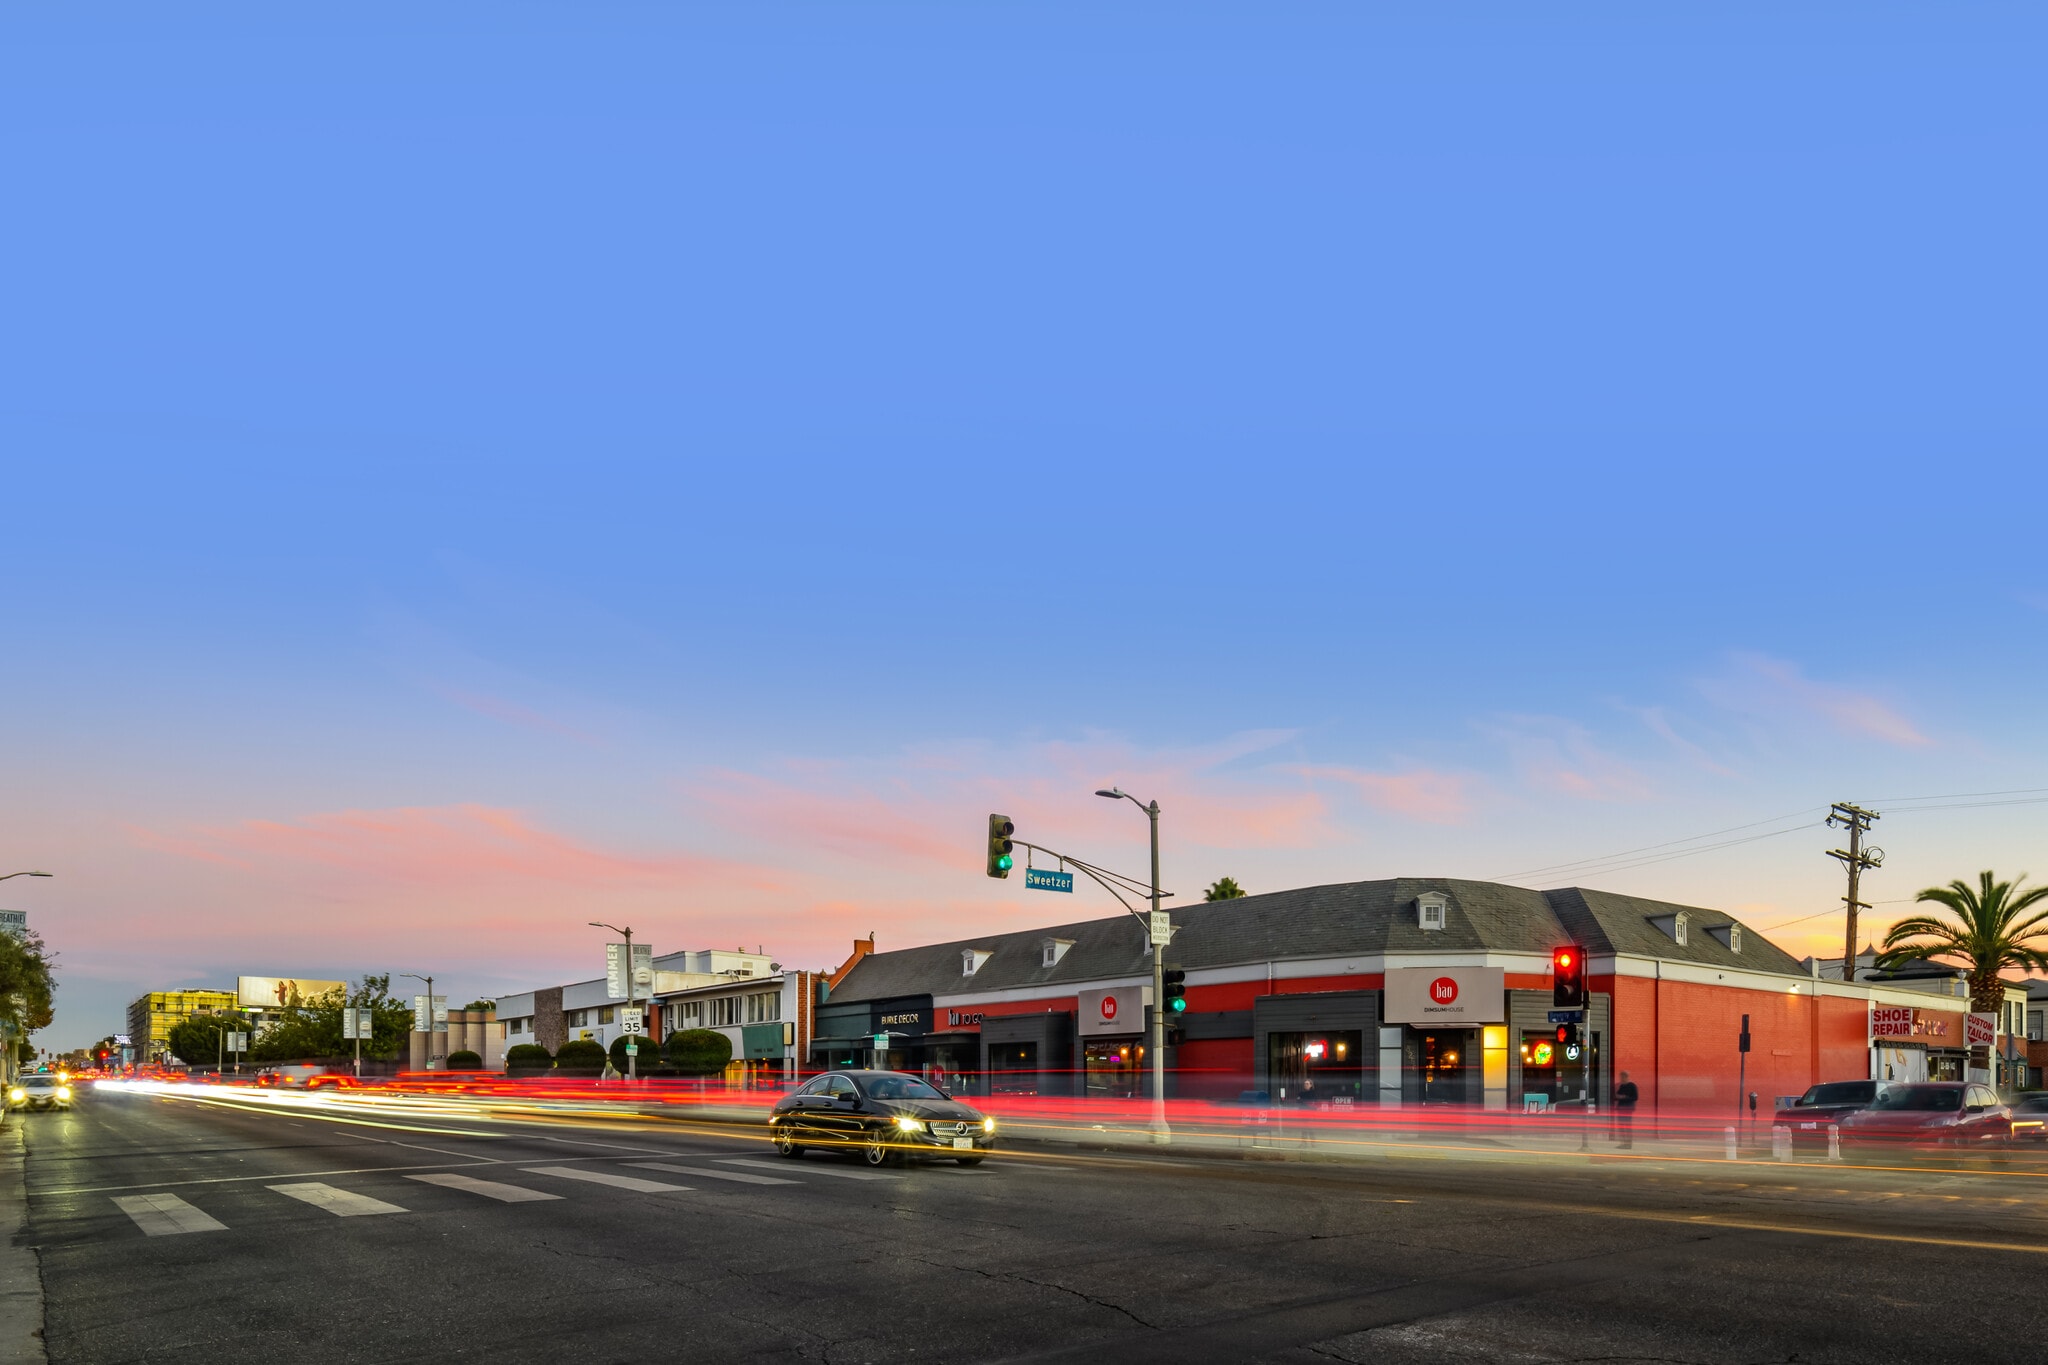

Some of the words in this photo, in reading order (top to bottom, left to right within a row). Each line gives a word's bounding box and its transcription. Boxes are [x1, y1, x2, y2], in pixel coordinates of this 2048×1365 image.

[1027, 873, 1071, 888] Sweetzer
[1152, 915, 1159, 923] DO
[1160, 916, 1168, 924] NOT
[1152, 925, 1168, 934] BLOCK
[607, 944, 619, 998] HAMMER
[1436, 982, 1452, 998] bao
[881, 1014, 898, 1025] BURKE
[898, 1013, 919, 1023] DECOR
[962, 1014, 971, 1024] TO
[1873, 1009, 1910, 1022] SHOE
[624, 1022, 640, 1032] 35
[1873, 1022, 1910, 1036] REPAIR
[1968, 1014, 1993, 1031] CUSTOM
[1968, 1025, 1993, 1044] TAILOR
